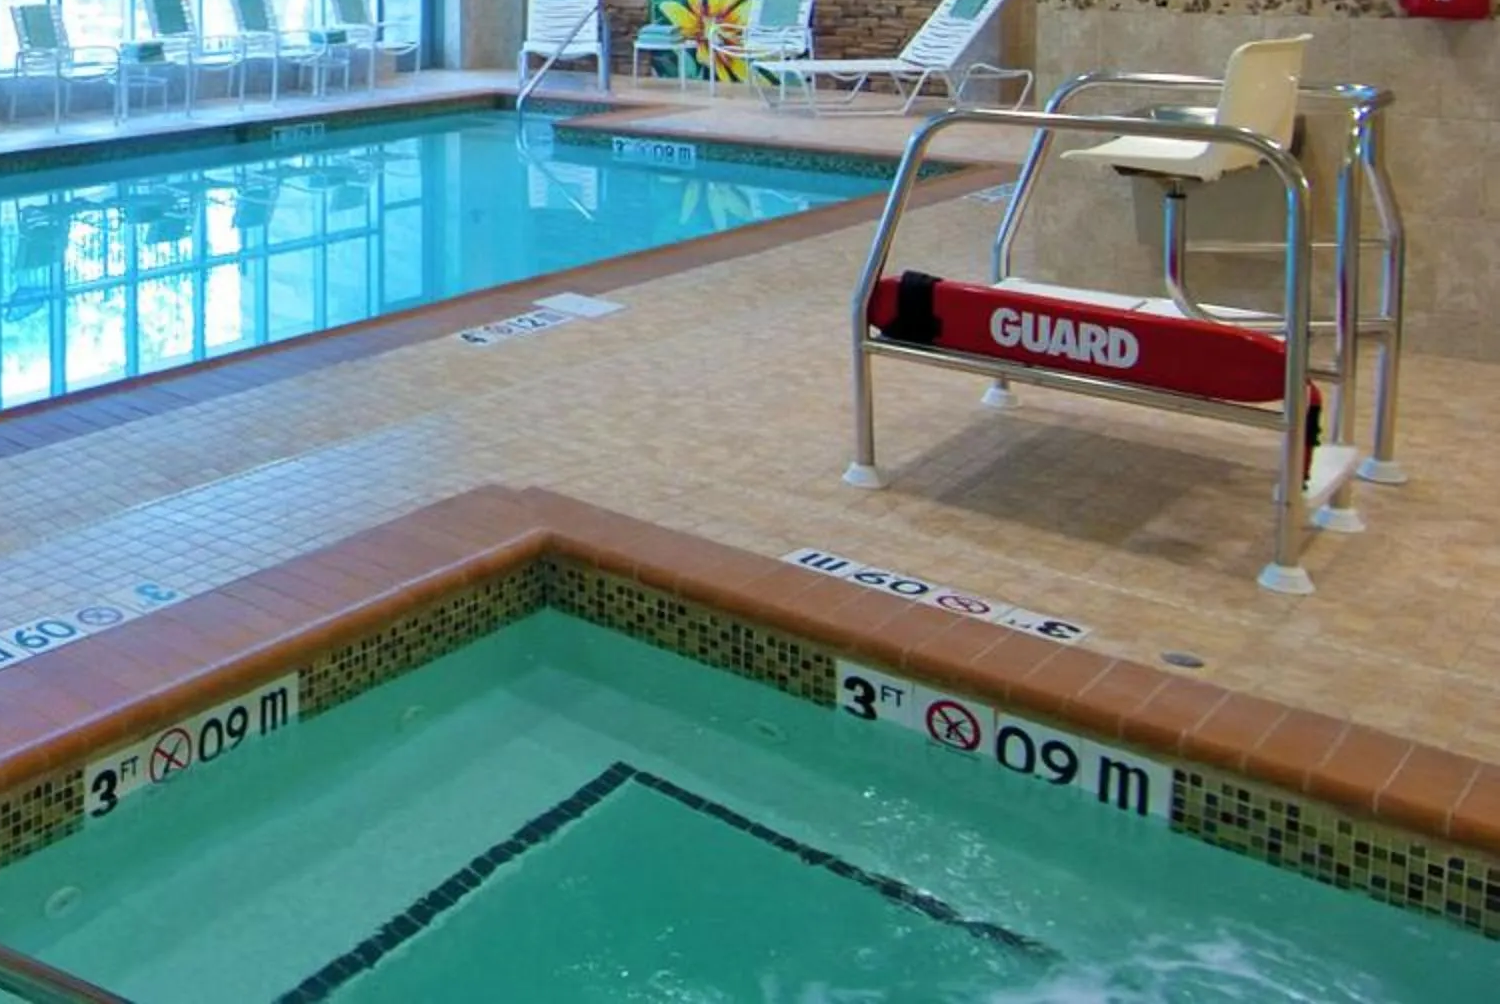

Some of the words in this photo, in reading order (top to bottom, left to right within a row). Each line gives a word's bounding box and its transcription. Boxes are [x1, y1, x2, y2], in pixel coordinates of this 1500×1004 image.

[990, 308, 1140, 369] GUARD
[259, 687, 288, 736] m
[1098, 755, 1150, 817] m
